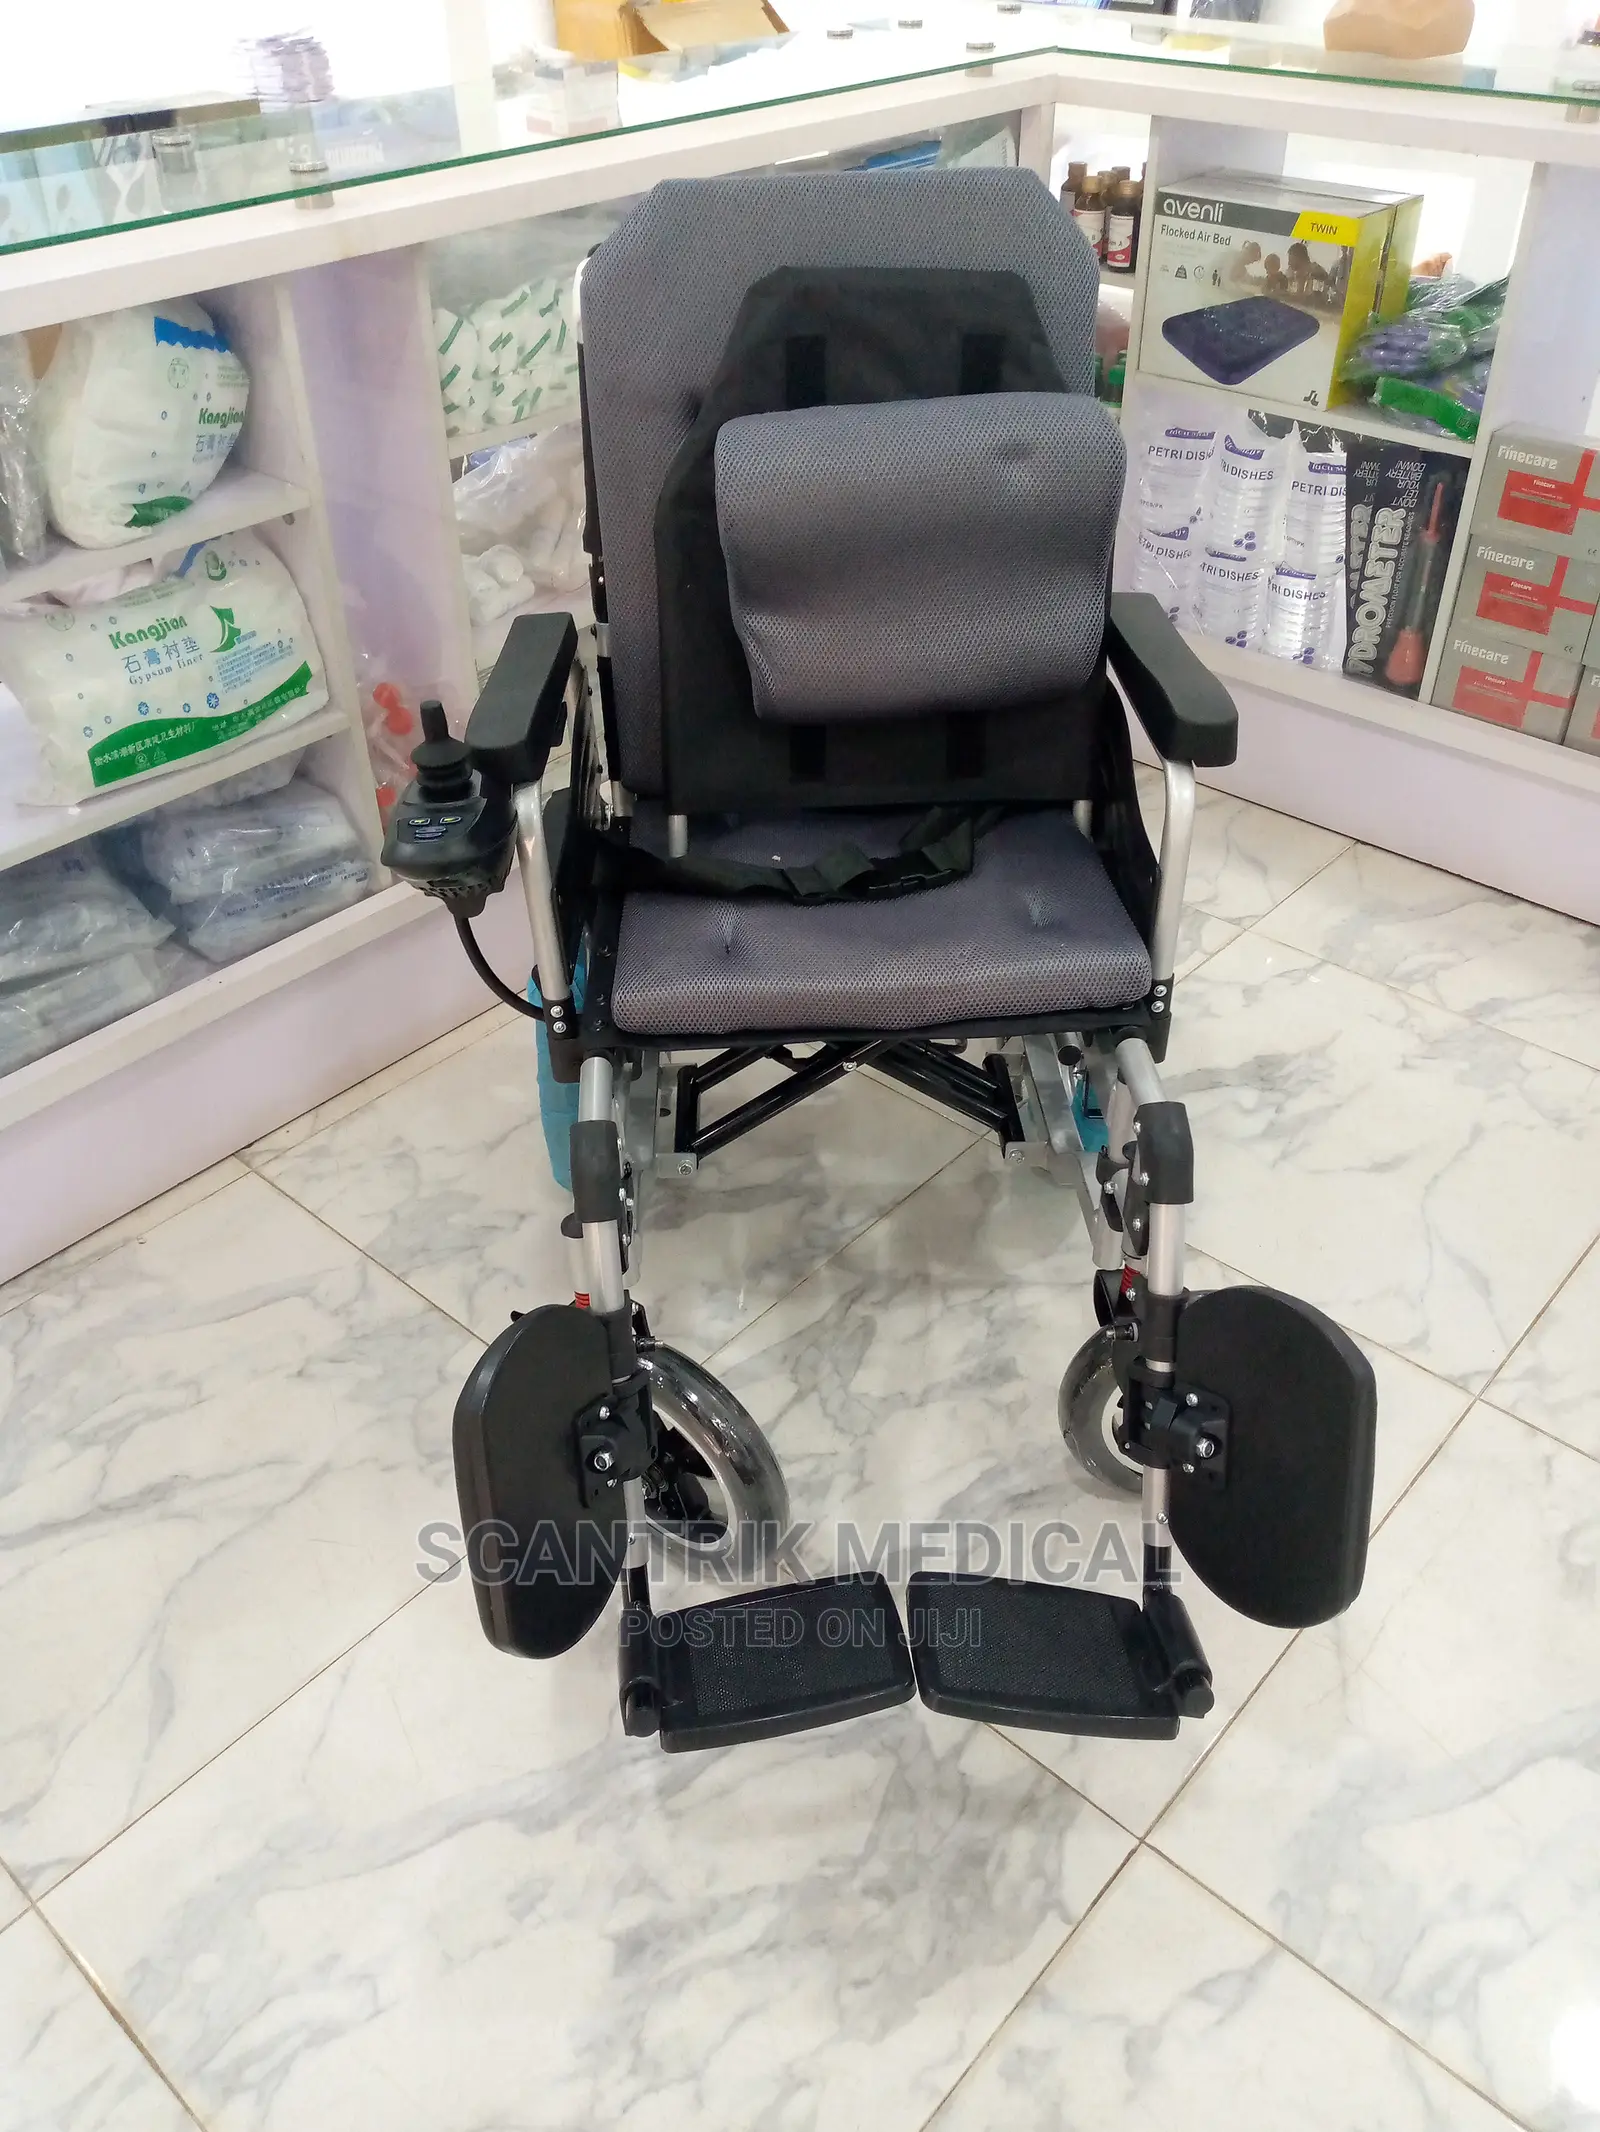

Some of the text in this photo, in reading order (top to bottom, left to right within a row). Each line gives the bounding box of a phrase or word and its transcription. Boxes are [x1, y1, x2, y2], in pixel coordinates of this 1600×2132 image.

[1163, 198, 1224, 222] avenli
[1160, 223, 1232, 246] Flocked Air Bed
[1310, 222, 1338, 235] TWIN
[1148, 445, 1182, 460] PETRI
[1395, 460, 1426, 472] DOWN!
[1230, 467, 1274, 480] DISHES
[1385, 469, 1423, 481] BATTERY
[1291, 480, 1347, 497] PETRI DIS
[1397, 480, 1420, 490] YOUR
[1403, 489, 1419, 499] LET
[1219, 568, 1259, 582] DISHES
[108, 615, 188, 650] Kangjian
[128, 653, 204, 685] Gypsum liner
